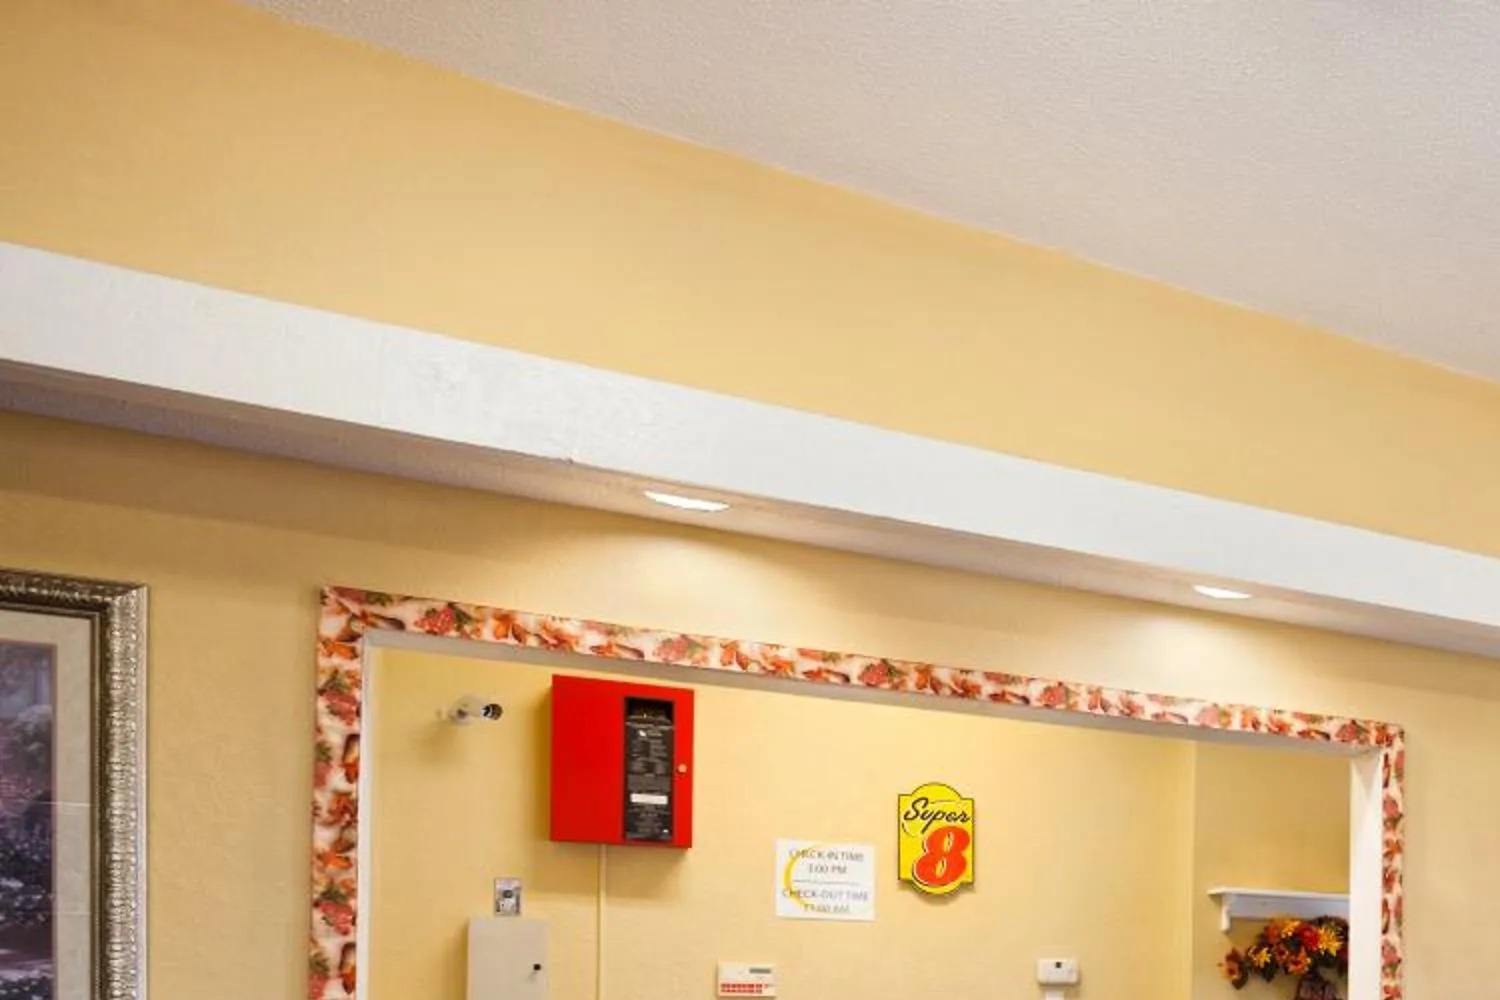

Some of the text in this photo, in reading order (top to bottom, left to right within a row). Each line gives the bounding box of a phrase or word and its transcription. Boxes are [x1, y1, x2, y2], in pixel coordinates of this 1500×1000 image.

[903, 797, 971, 834] Super
[839, 852, 865, 862] TIME
[912, 826, 971, 887] 8
[831, 864, 848, 874] PM
[845, 890, 868, 901] TIME
